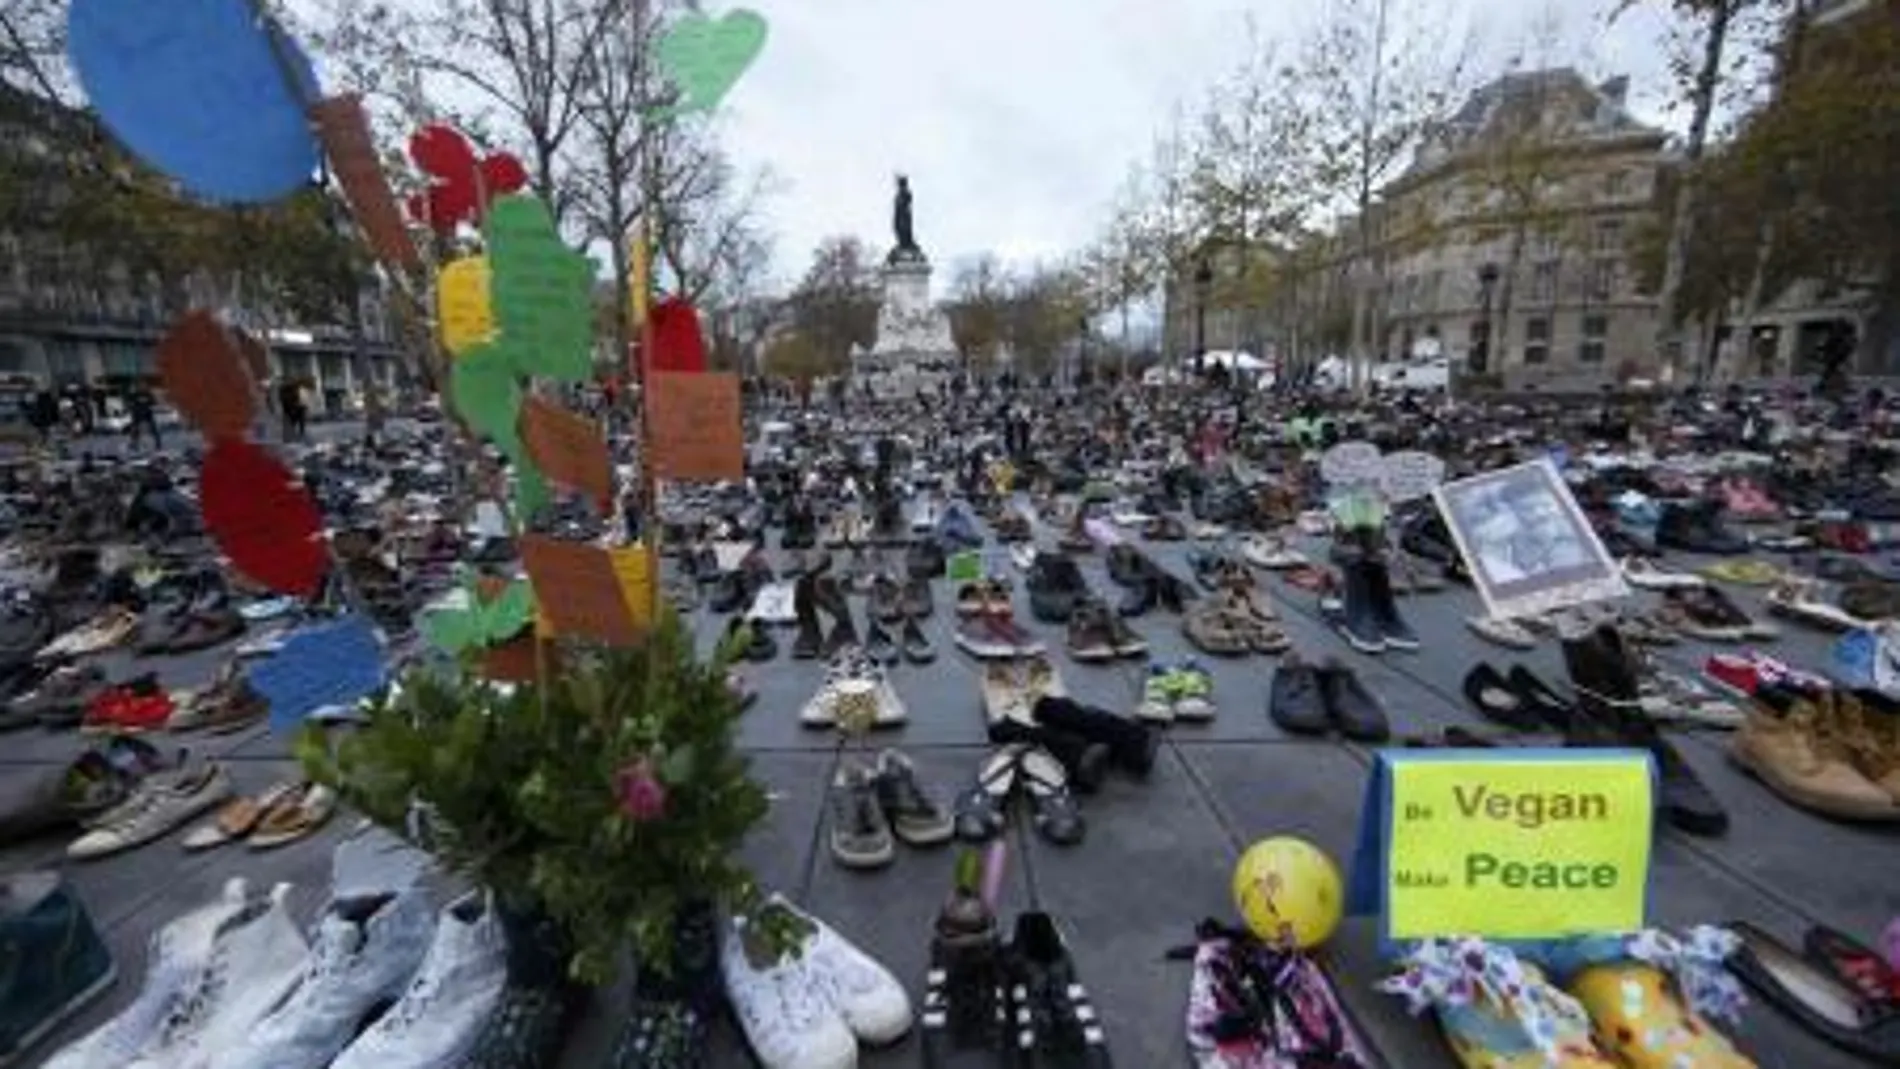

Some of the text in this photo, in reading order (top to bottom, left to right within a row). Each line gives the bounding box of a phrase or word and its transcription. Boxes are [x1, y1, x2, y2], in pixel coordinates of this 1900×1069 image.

[1405, 785, 1609, 829] Be Vegan
[1394, 853, 1618, 889] Make Peace
